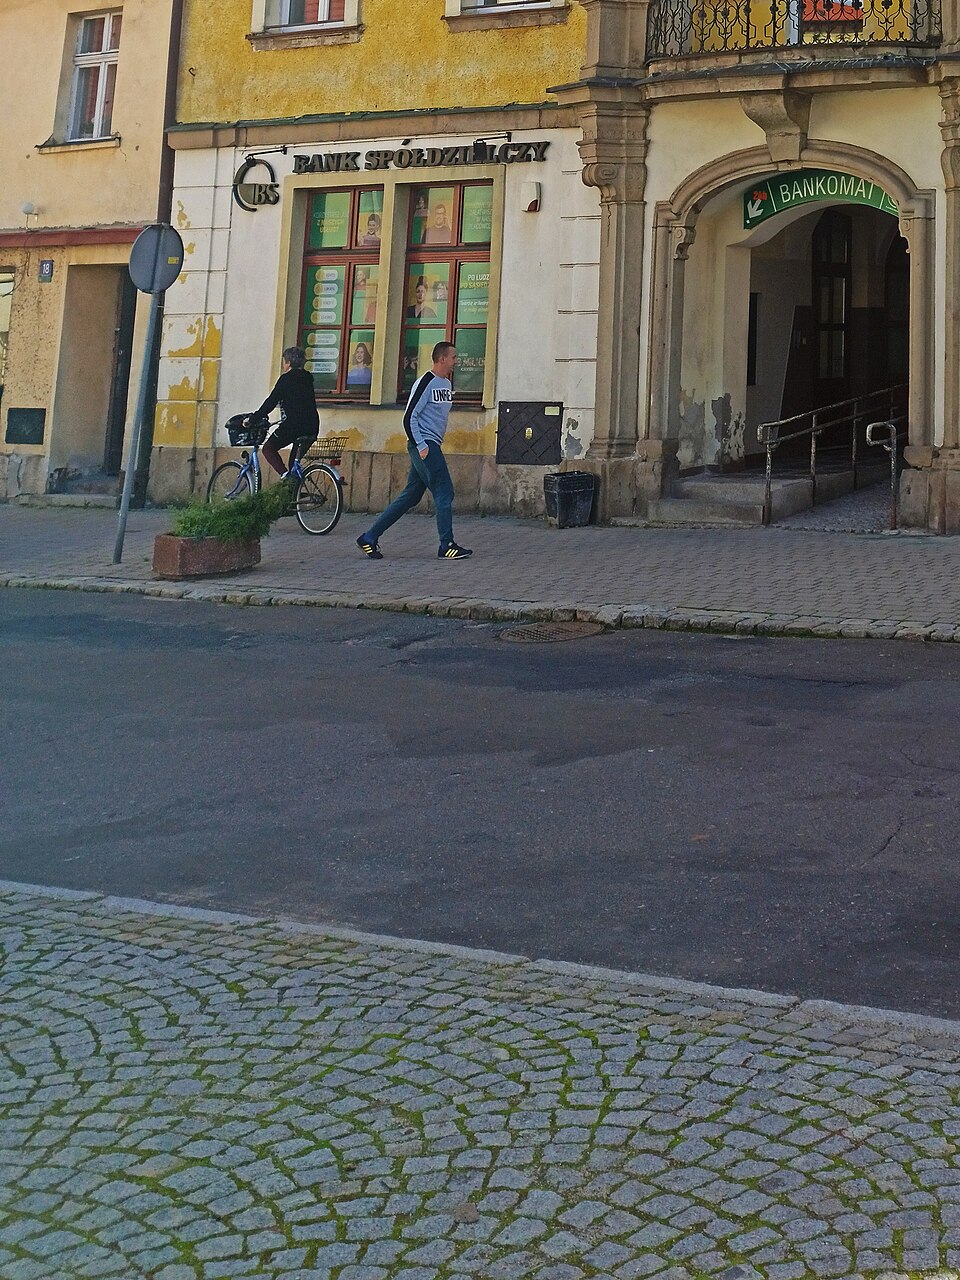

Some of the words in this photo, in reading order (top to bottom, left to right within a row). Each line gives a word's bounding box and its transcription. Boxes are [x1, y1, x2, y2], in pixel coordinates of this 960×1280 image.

[292, 152, 360, 174] BANK
[254, 183, 280, 205] BS
[43, 263, 49, 274] 18
